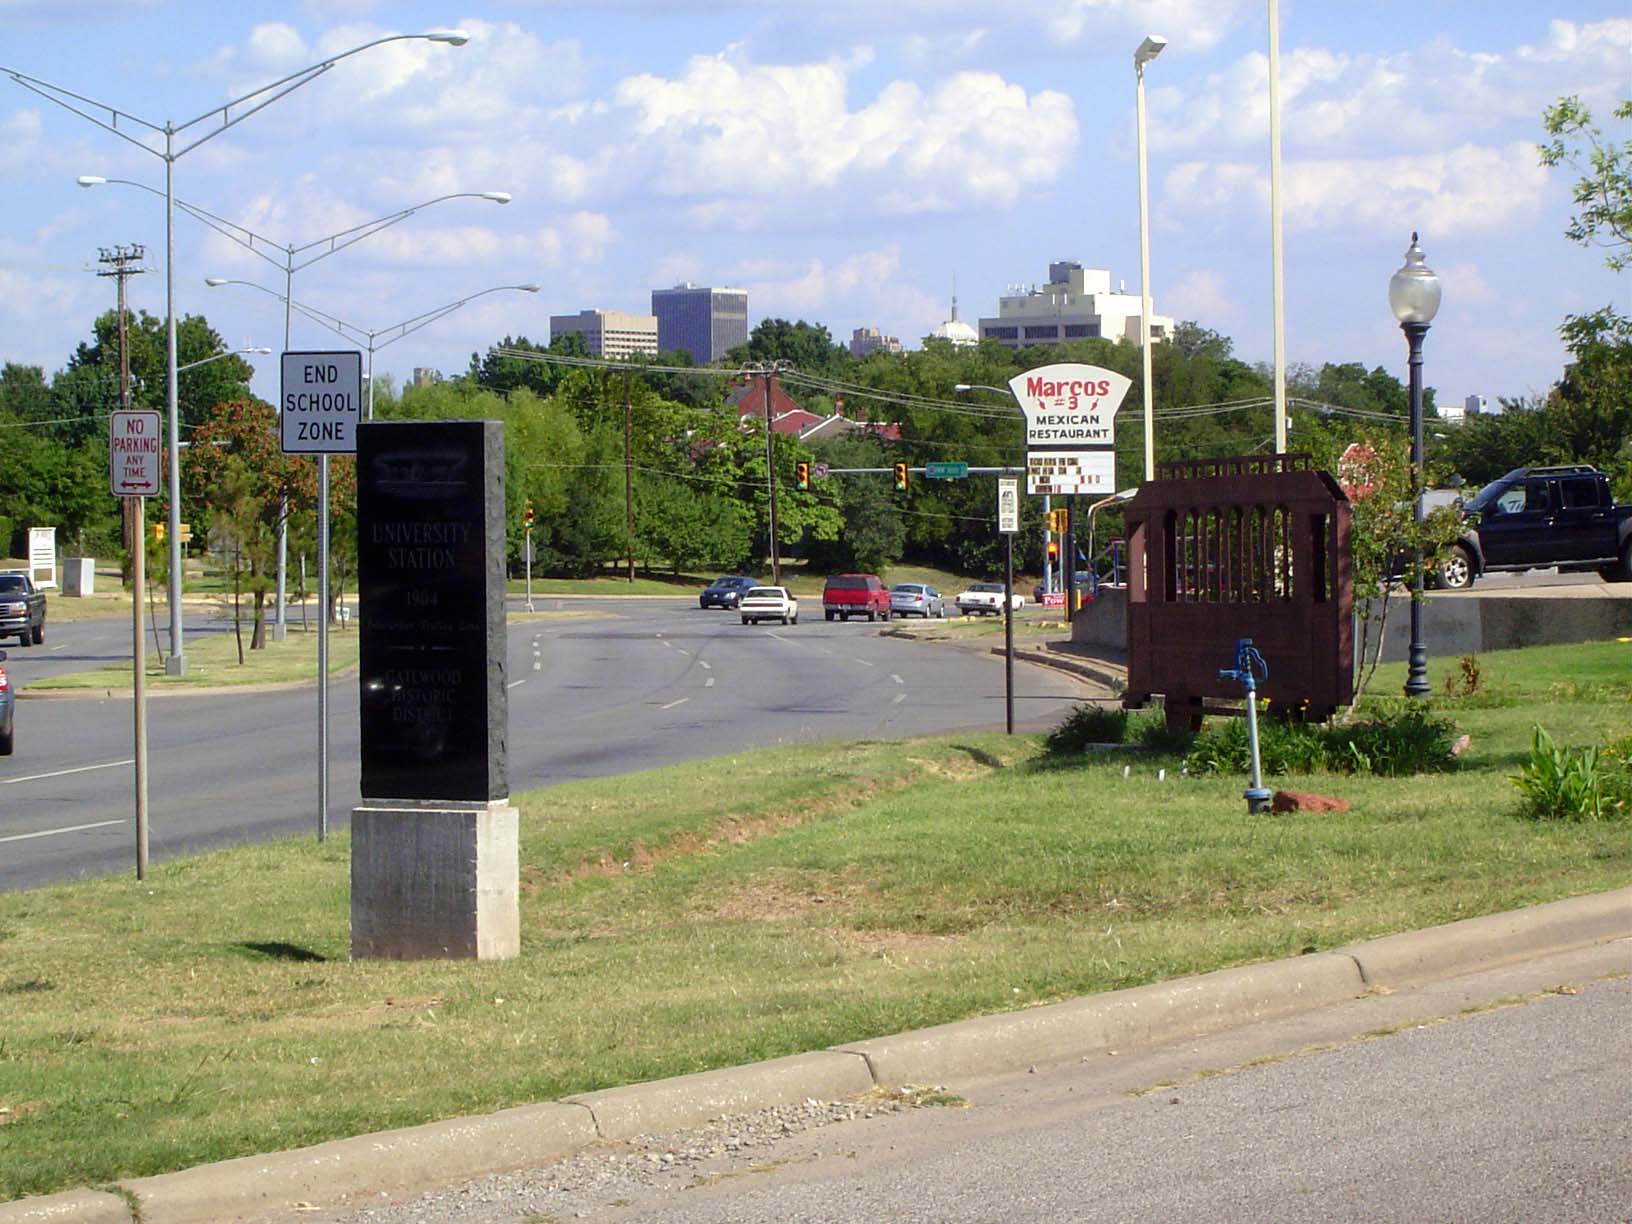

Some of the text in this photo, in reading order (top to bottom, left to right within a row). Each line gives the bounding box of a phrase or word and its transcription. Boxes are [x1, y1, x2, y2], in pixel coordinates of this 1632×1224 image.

[304, 365, 338, 383] END
[1027, 377, 1110, 397] Marcos
[286, 393, 356, 412] SCHOOL
[126, 419, 144, 435] NO
[1036, 415, 1100, 425] MEXICAN
[298, 422, 344, 440] ZONE
[1029, 429, 1110, 439] RESTAURANT
[114, 437, 157, 454] PARKING
[125, 455, 144, 465] ANY
[123, 467, 146, 478] TIME
[372, 521, 472, 544] UNIVERSITY
[387, 547, 456, 569] STATION
